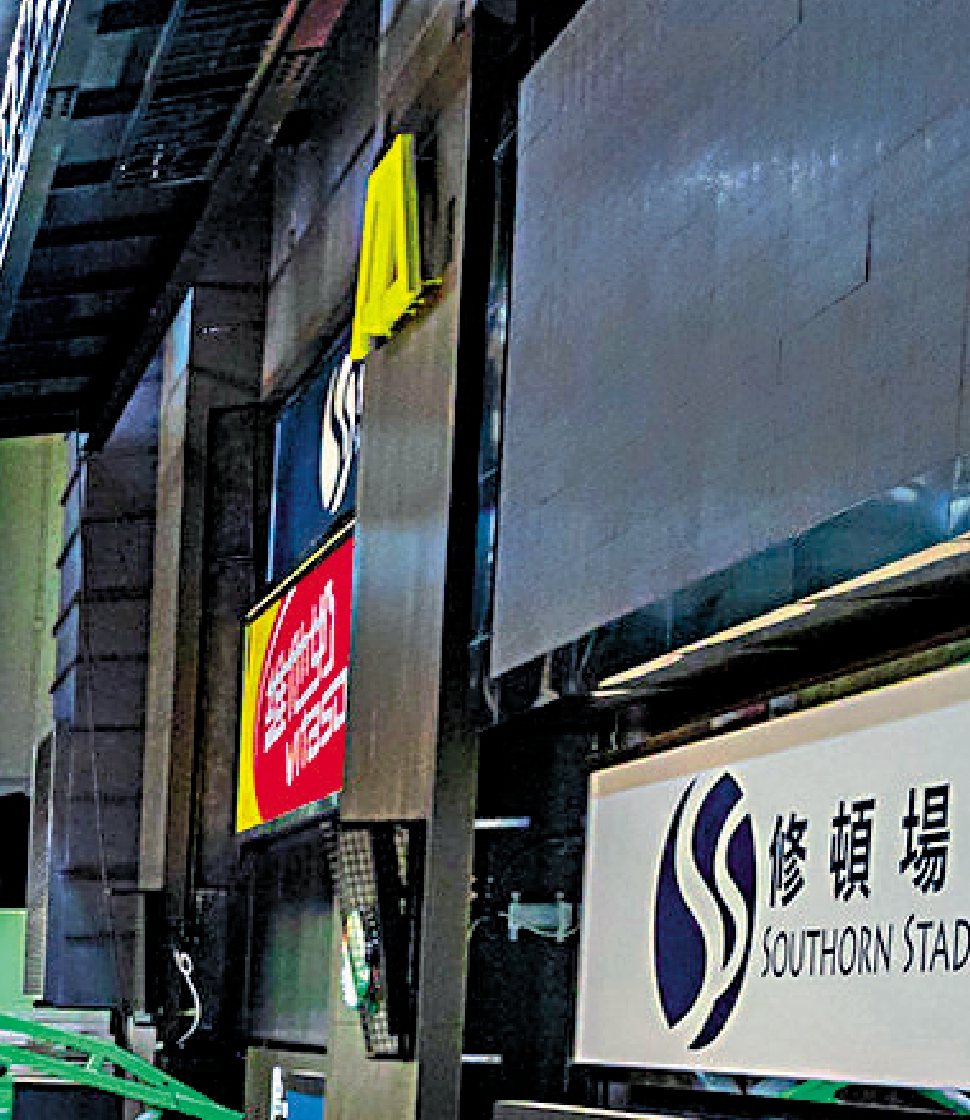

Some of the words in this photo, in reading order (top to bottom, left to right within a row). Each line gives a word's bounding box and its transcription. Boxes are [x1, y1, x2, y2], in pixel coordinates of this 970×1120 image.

[768, 783, 951, 909] 修頓場
[761, 924, 894, 978] SOUTHORN
